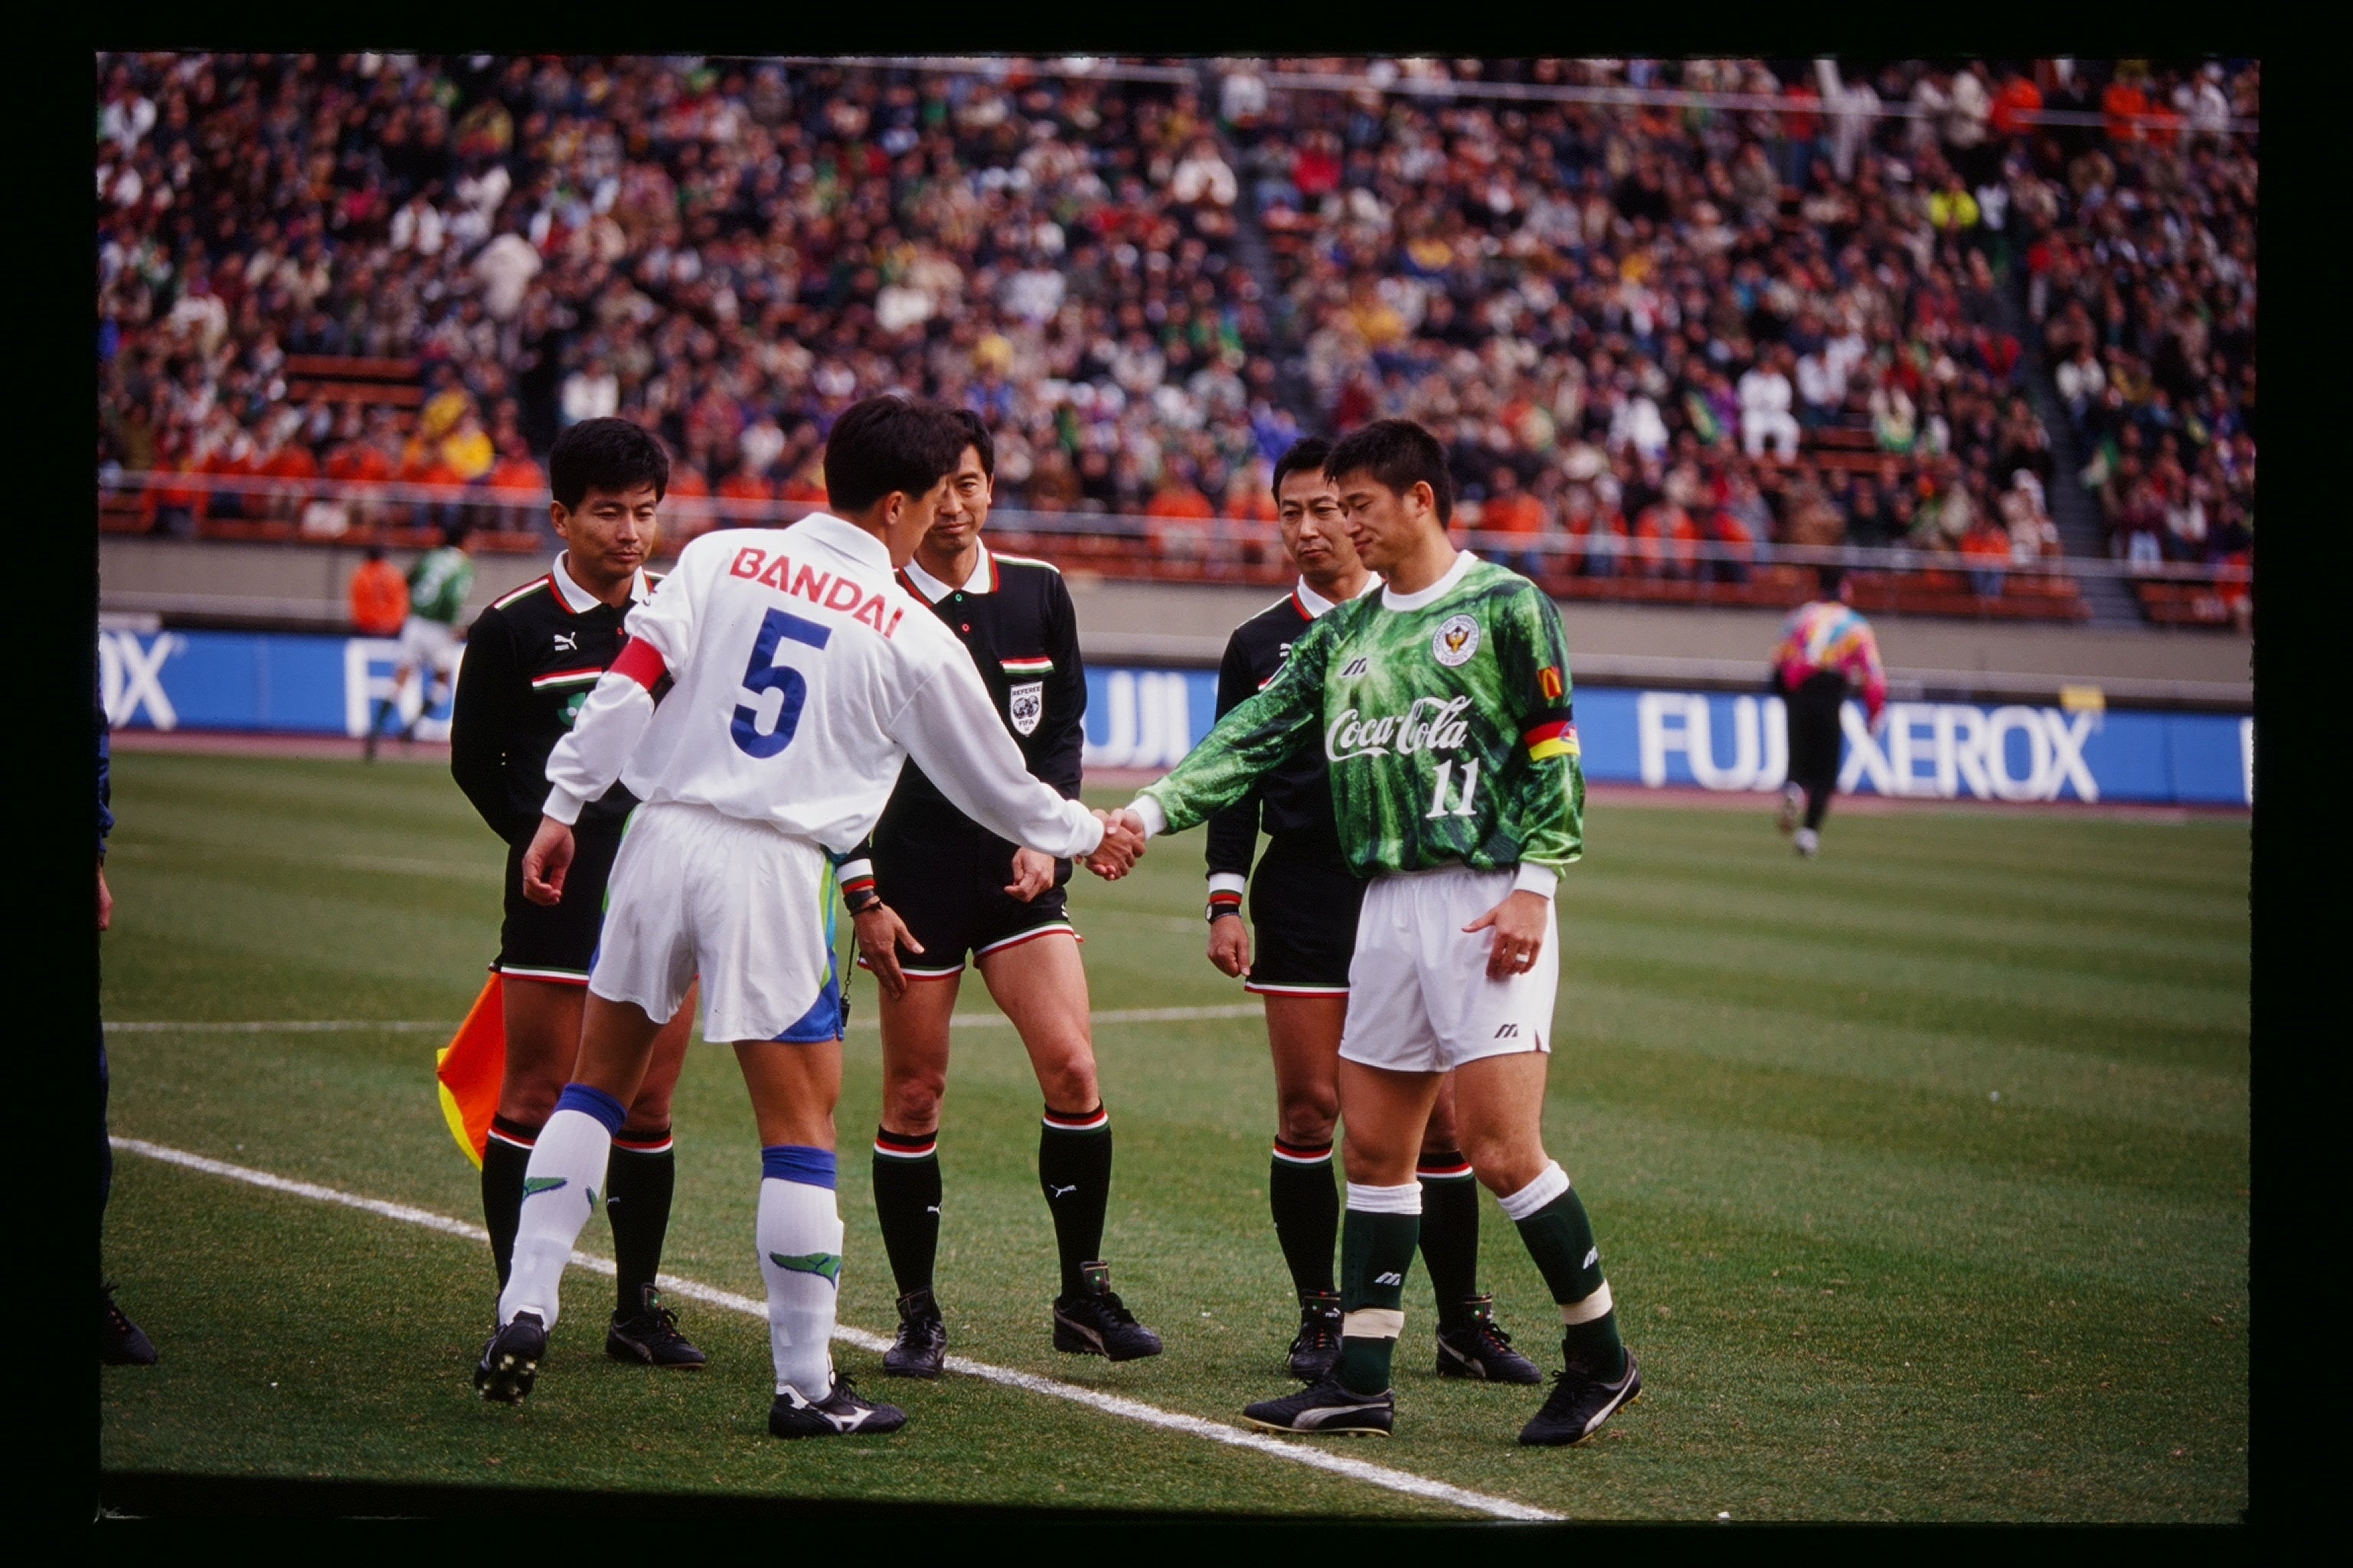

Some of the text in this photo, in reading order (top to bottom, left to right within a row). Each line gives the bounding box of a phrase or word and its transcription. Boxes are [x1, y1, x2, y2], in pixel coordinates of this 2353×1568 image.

[729, 547, 905, 639] BANDAI
[730, 607, 832, 759] 5
[1011, 685, 1041, 696] REFEREE
[1325, 694, 1474, 762] Coca-Cola
[1838, 699, 2100, 804] XEROX
[1425, 756, 1479, 818] 11
